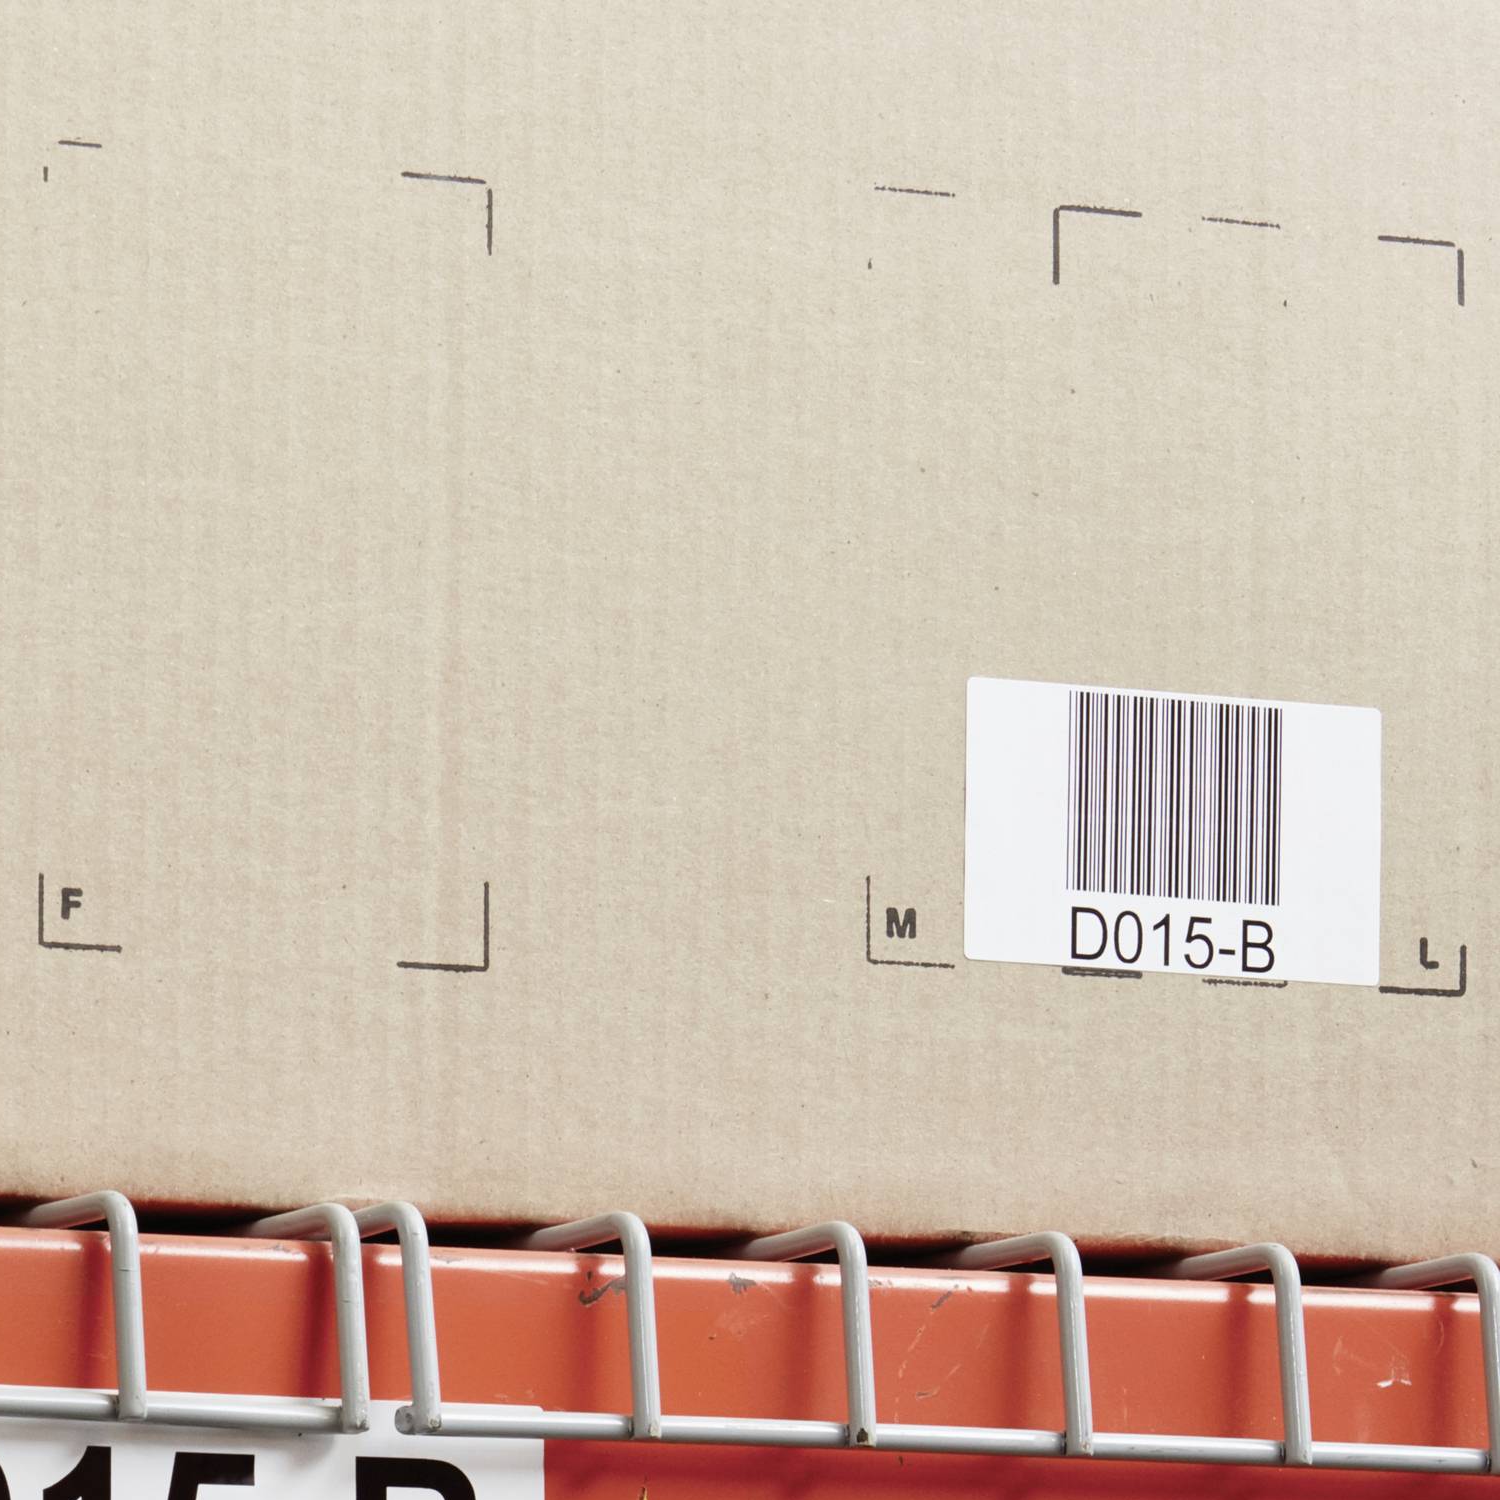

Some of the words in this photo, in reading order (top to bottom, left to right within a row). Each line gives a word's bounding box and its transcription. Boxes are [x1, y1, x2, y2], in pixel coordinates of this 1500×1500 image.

[60, 887, 83, 920] F
[885, 907, 917, 939] M
[1070, 906, 1276, 973] D015-B
[1419, 937, 1440, 970] L
